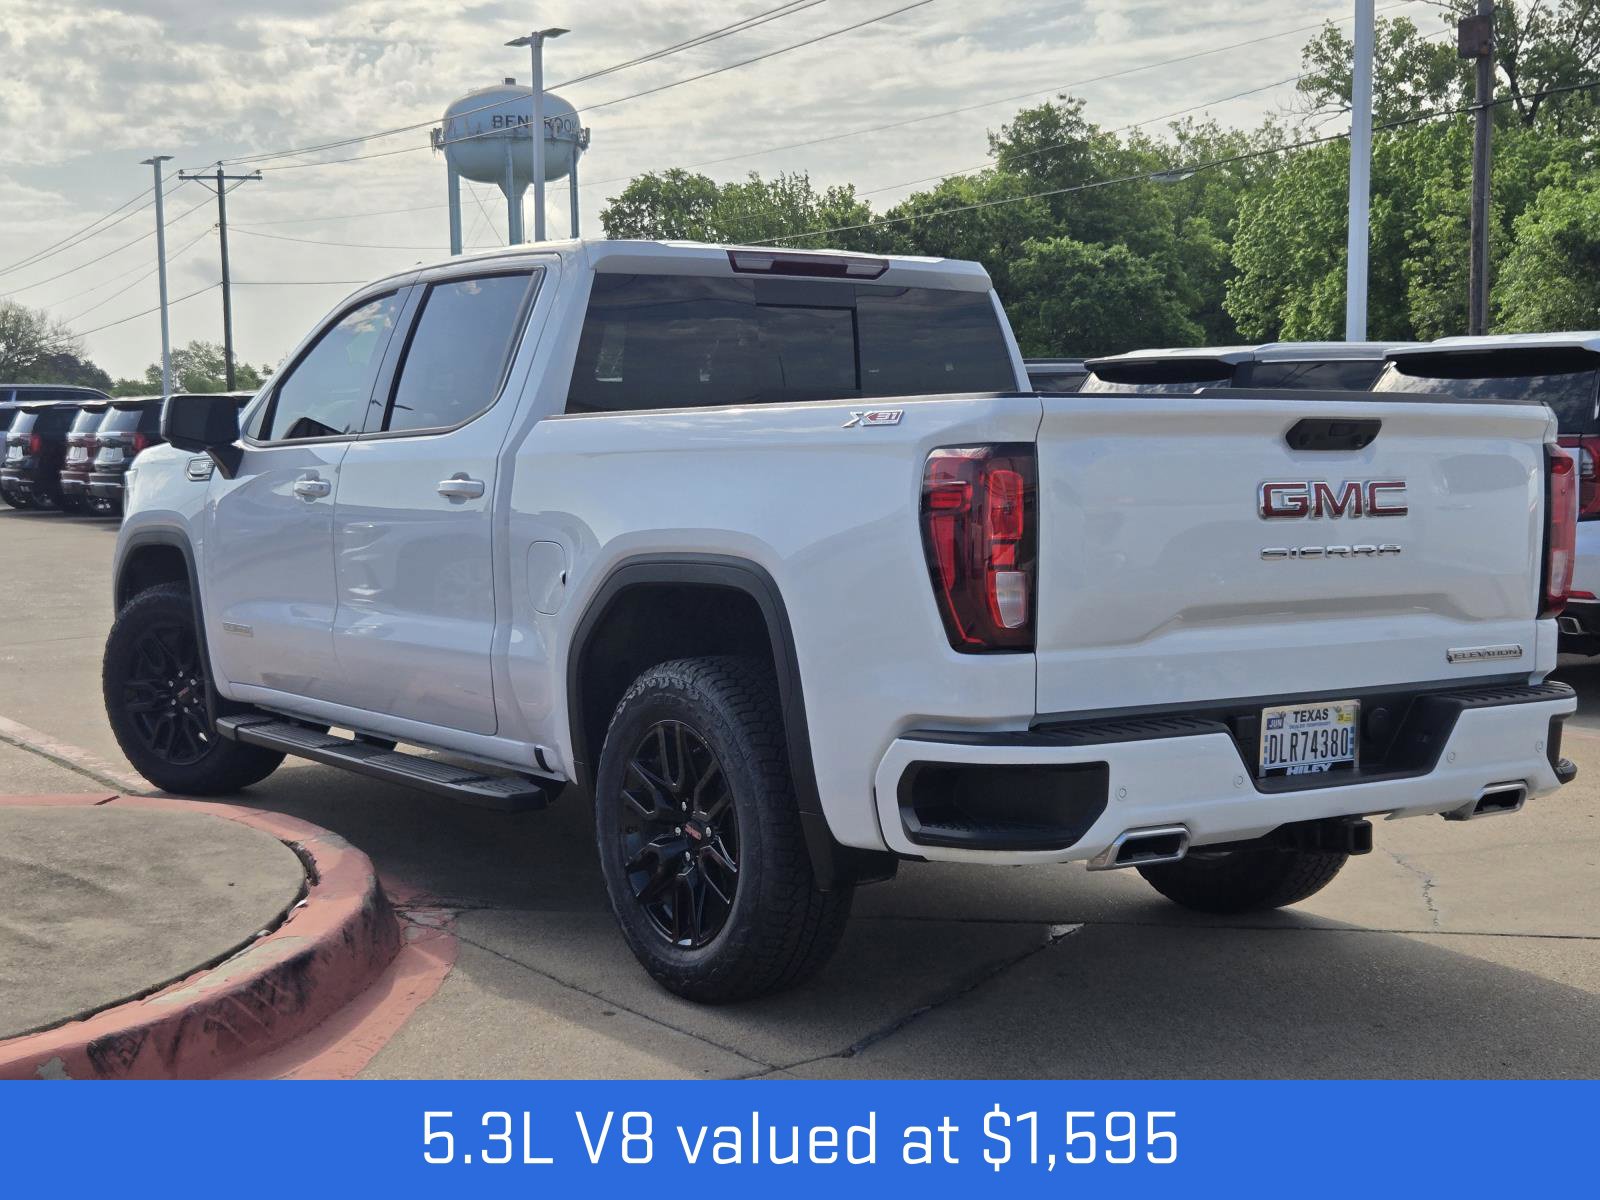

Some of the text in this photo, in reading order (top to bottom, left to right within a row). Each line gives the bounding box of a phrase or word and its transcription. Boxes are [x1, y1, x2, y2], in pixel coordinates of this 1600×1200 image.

[492, 114, 577, 134] BENROOK
[1258, 480, 1408, 519] GMC
[1261, 544, 1401, 560] SIERRA
[1454, 649, 1518, 659] ELEVATION
[1268, 718, 1283, 729] JUN
[1293, 708, 1329, 723] TEXAS
[1269, 728, 1349, 764] DLR74380
